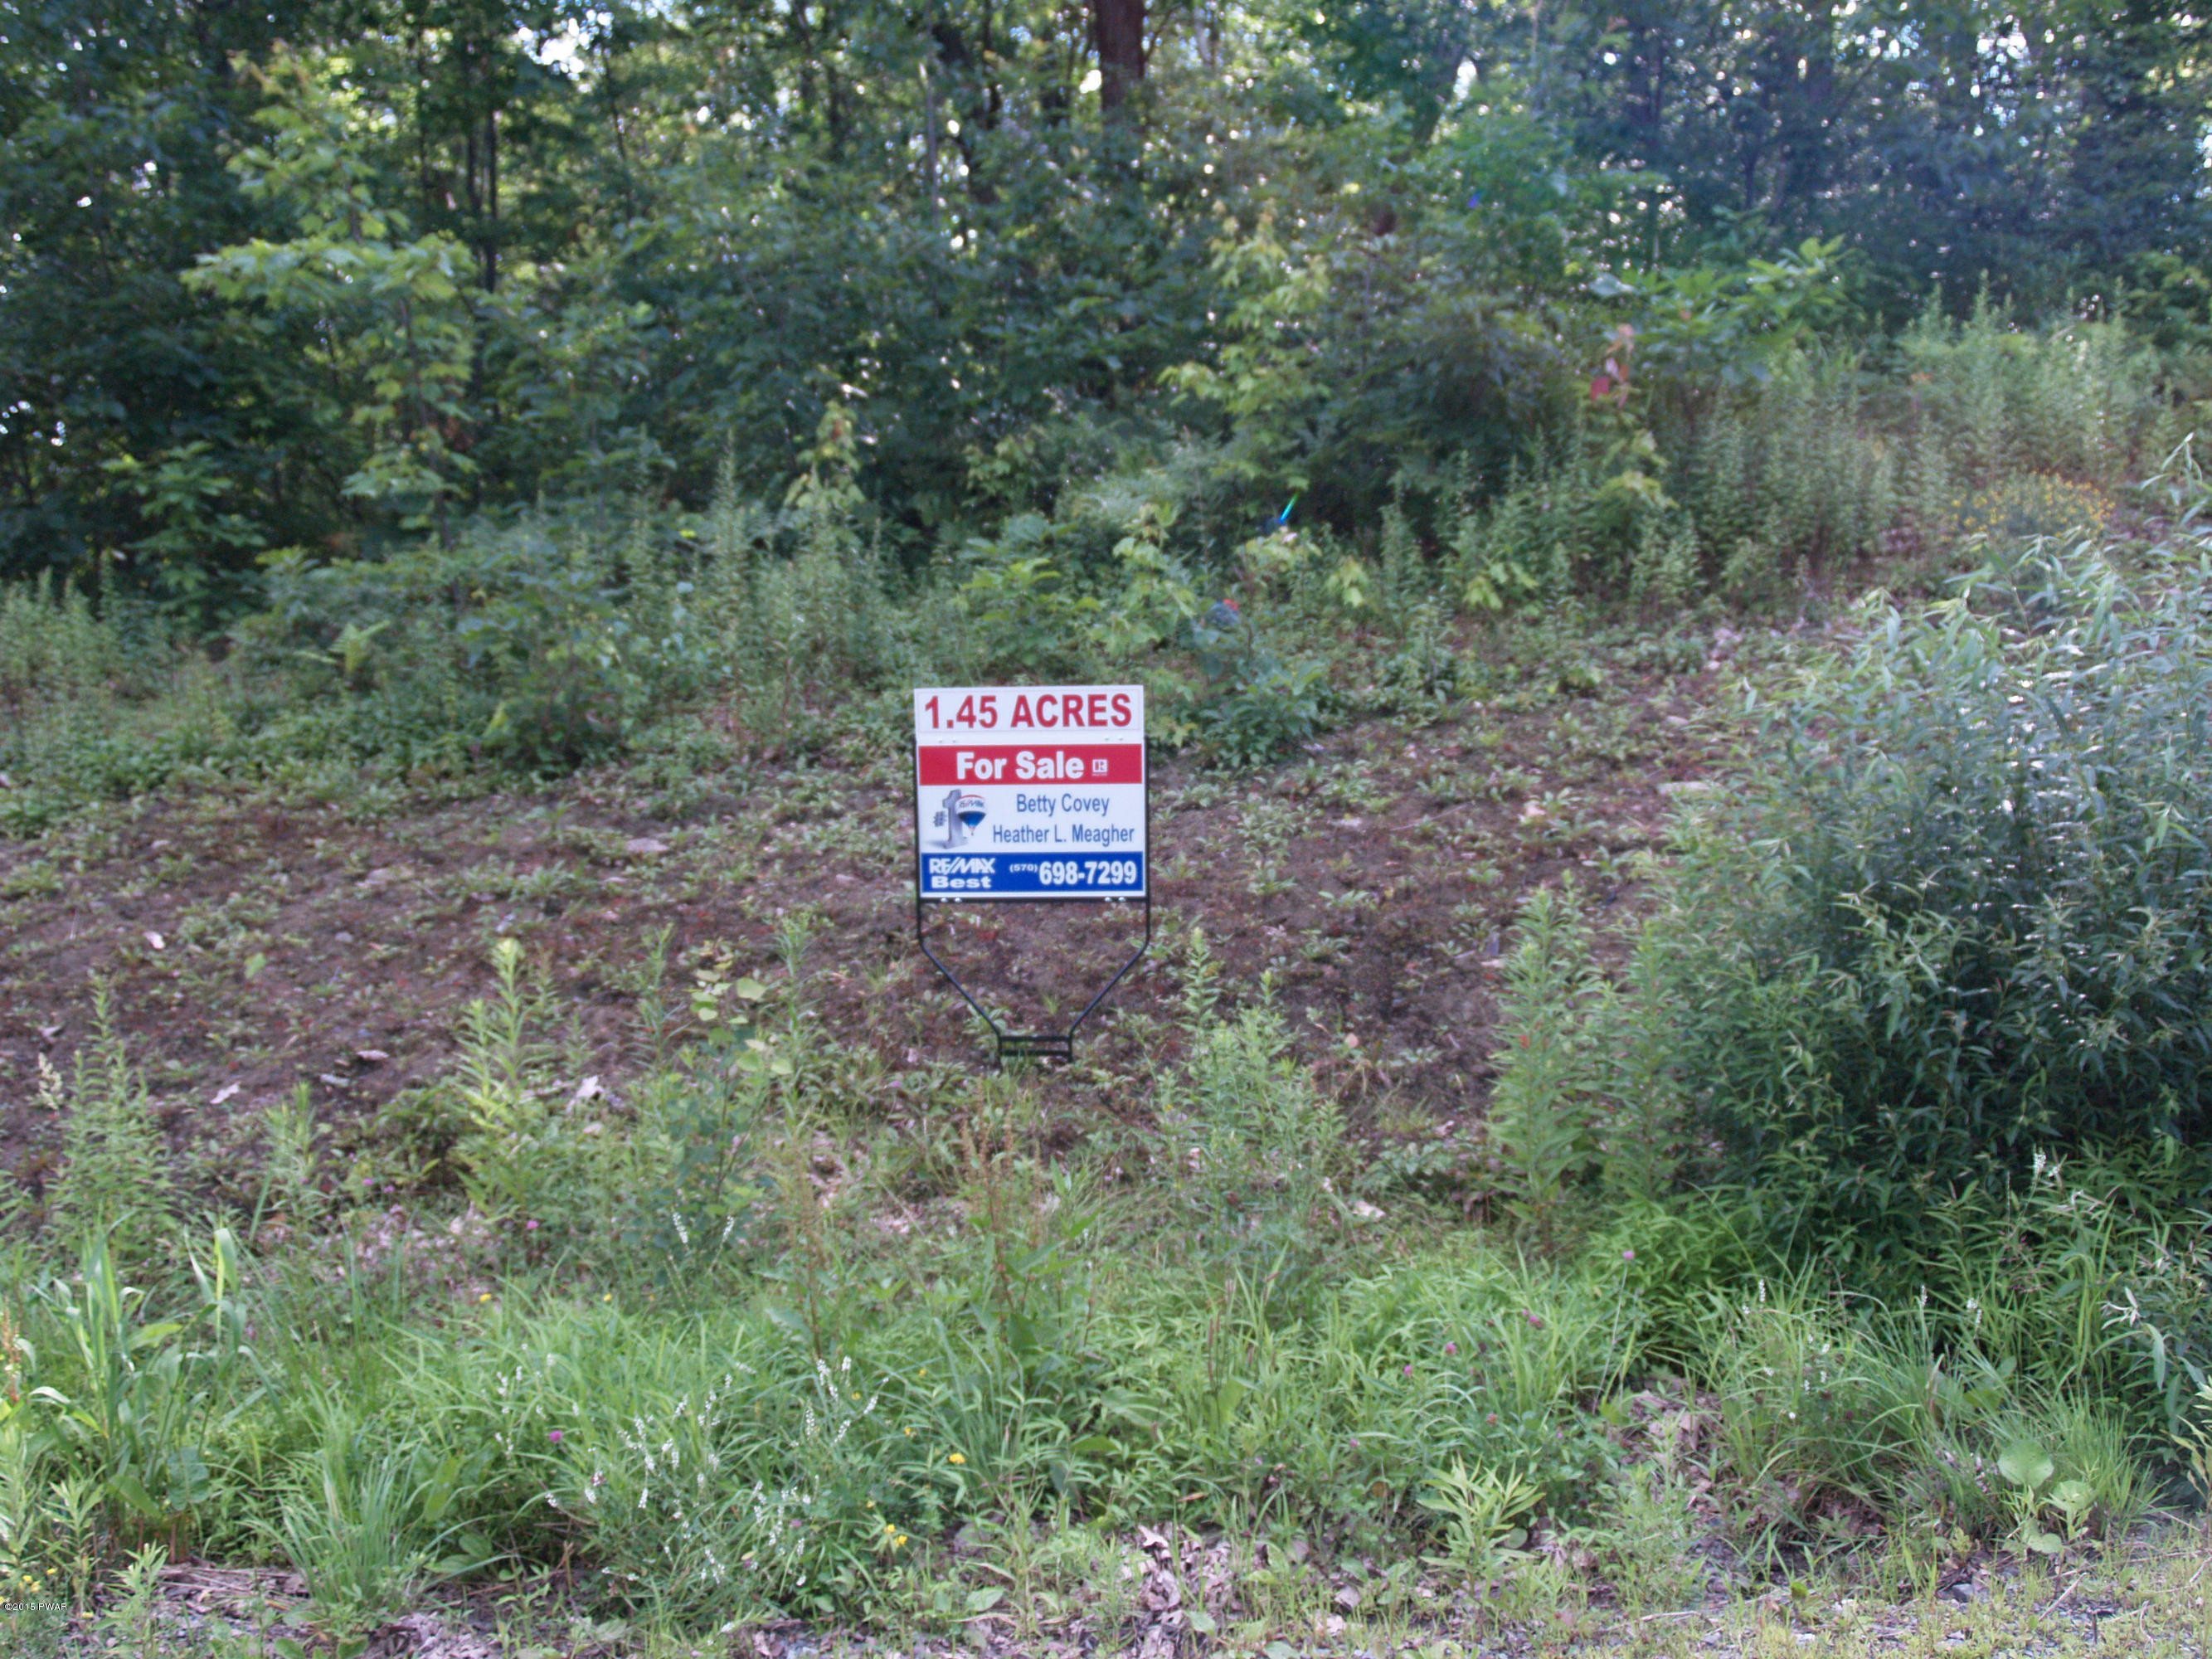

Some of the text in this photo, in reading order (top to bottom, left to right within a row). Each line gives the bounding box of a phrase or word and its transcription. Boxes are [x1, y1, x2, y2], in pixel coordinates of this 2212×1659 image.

[925, 693, 1131, 729] 1.45 ACRES
[956, 750, 1085, 780] For Sale
[1016, 793, 1110, 817] Betty Covey
[993, 824, 1135, 847] Heather L. Meagher
[929, 856, 995, 875] RE/MAX
[1009, 860, 1137, 885] (570) 698-7299
[931, 875, 991, 889] Best
